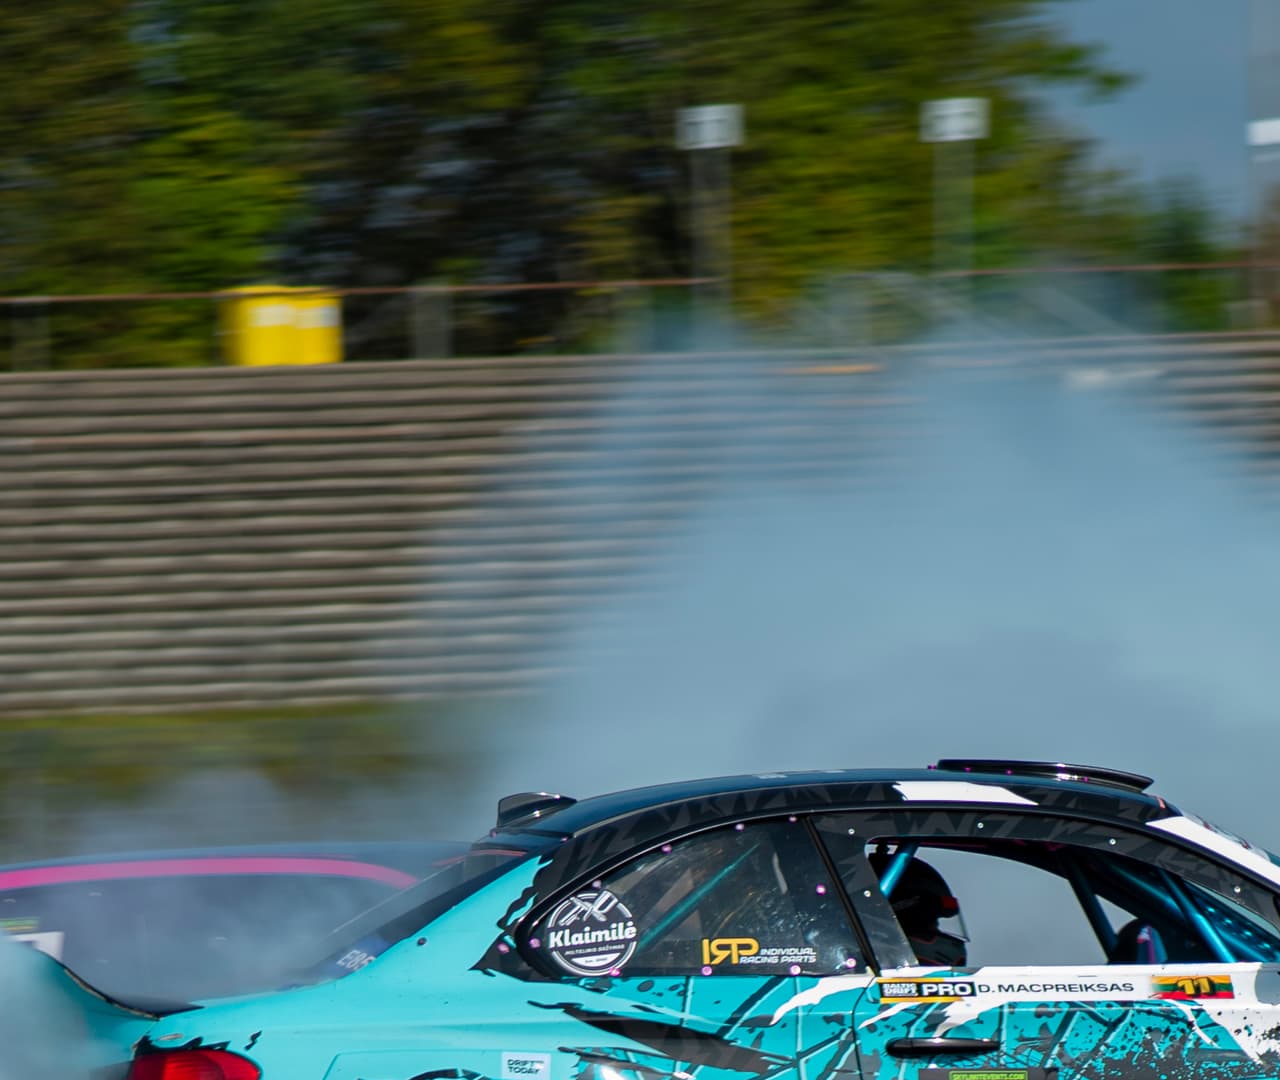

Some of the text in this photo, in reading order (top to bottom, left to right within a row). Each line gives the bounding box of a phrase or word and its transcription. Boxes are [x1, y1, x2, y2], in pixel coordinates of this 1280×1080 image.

[548, 920, 637, 949] Klaimilė
[760, 947, 817, 956] INDIVIDUAL
[739, 955, 817, 964] RACING PARTS
[922, 983, 972, 996] PRO
